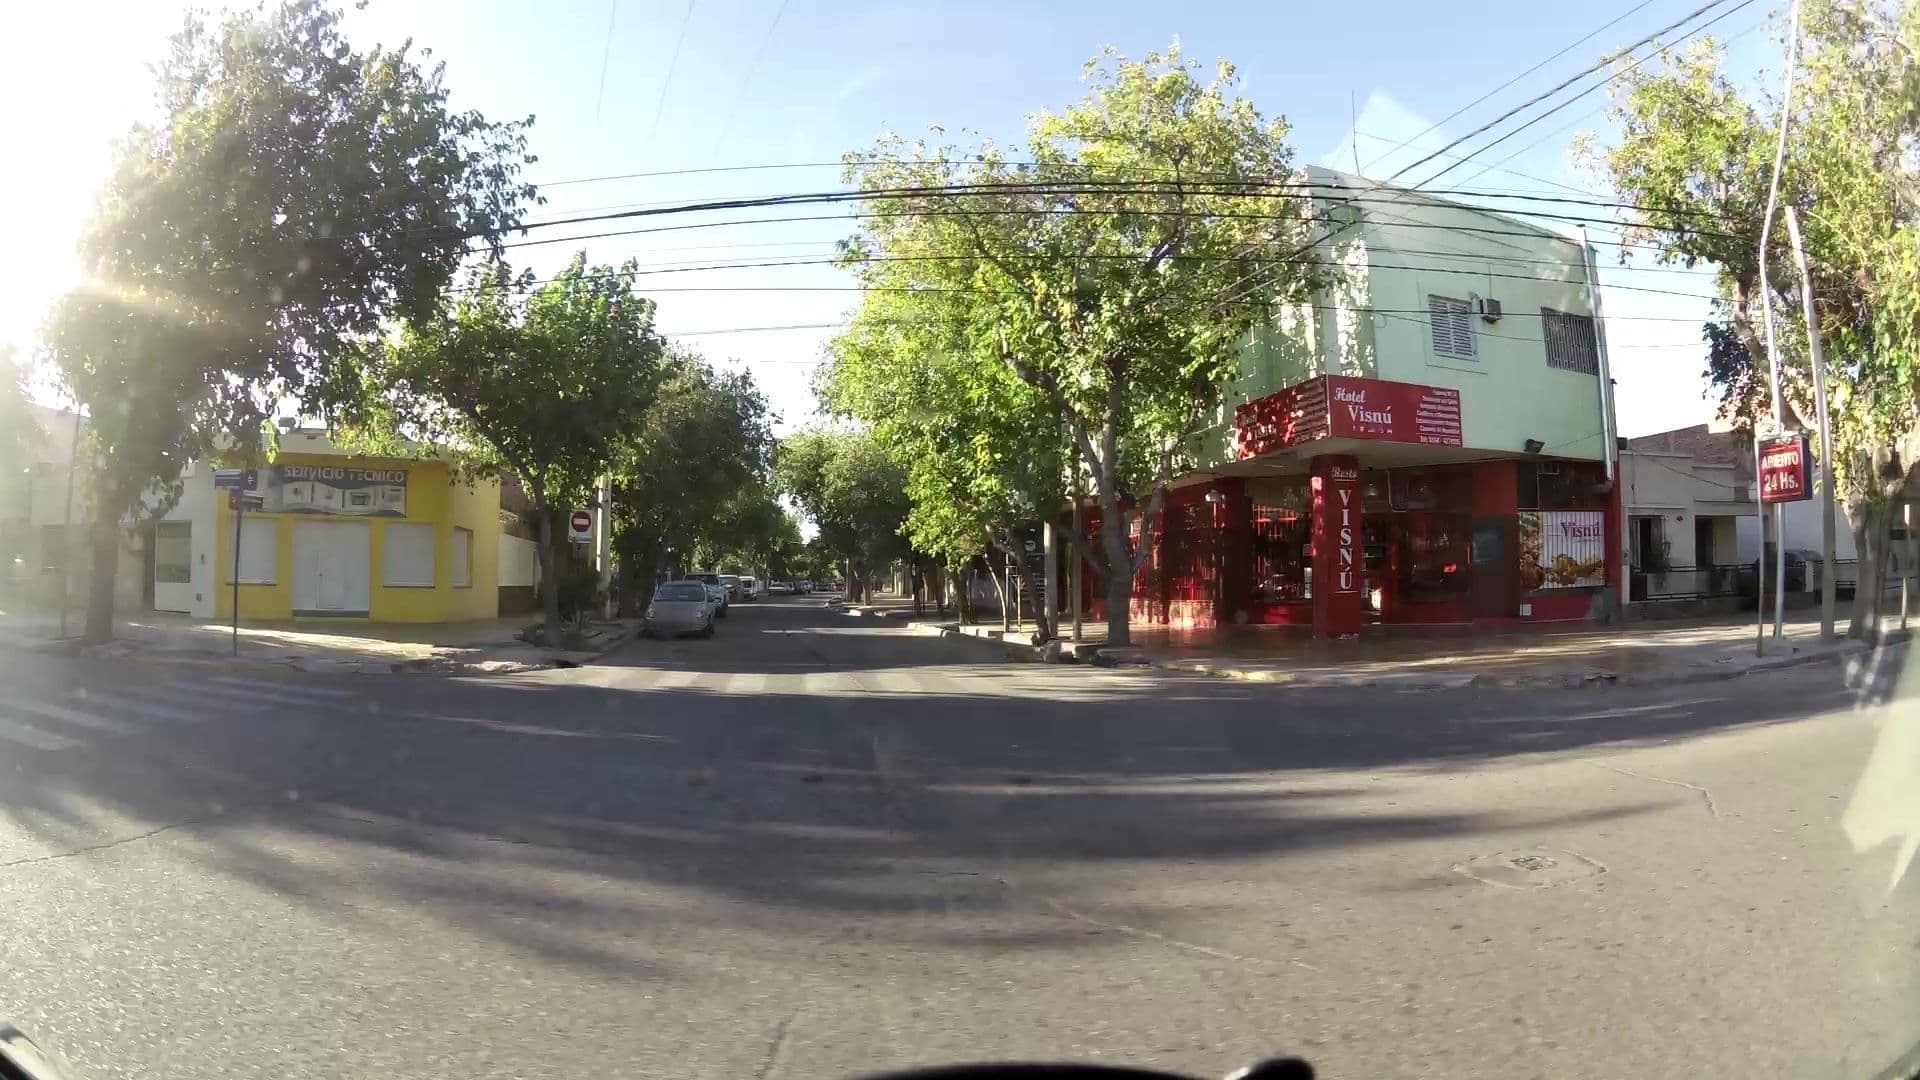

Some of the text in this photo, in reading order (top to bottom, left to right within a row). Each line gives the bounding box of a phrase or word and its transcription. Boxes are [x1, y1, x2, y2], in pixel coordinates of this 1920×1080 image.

[1334, 387, 1366, 403] Hotel
[1348, 404, 1392, 424] Visnú
[1761, 451, 1799, 470] ABIERTO
[287, 466, 345, 480] SERVICIO
[1764, 474, 1777, 492] 24
[1560, 521, 1601, 538] Visnú
[1338, 489, 1353, 590] VISNÚ
